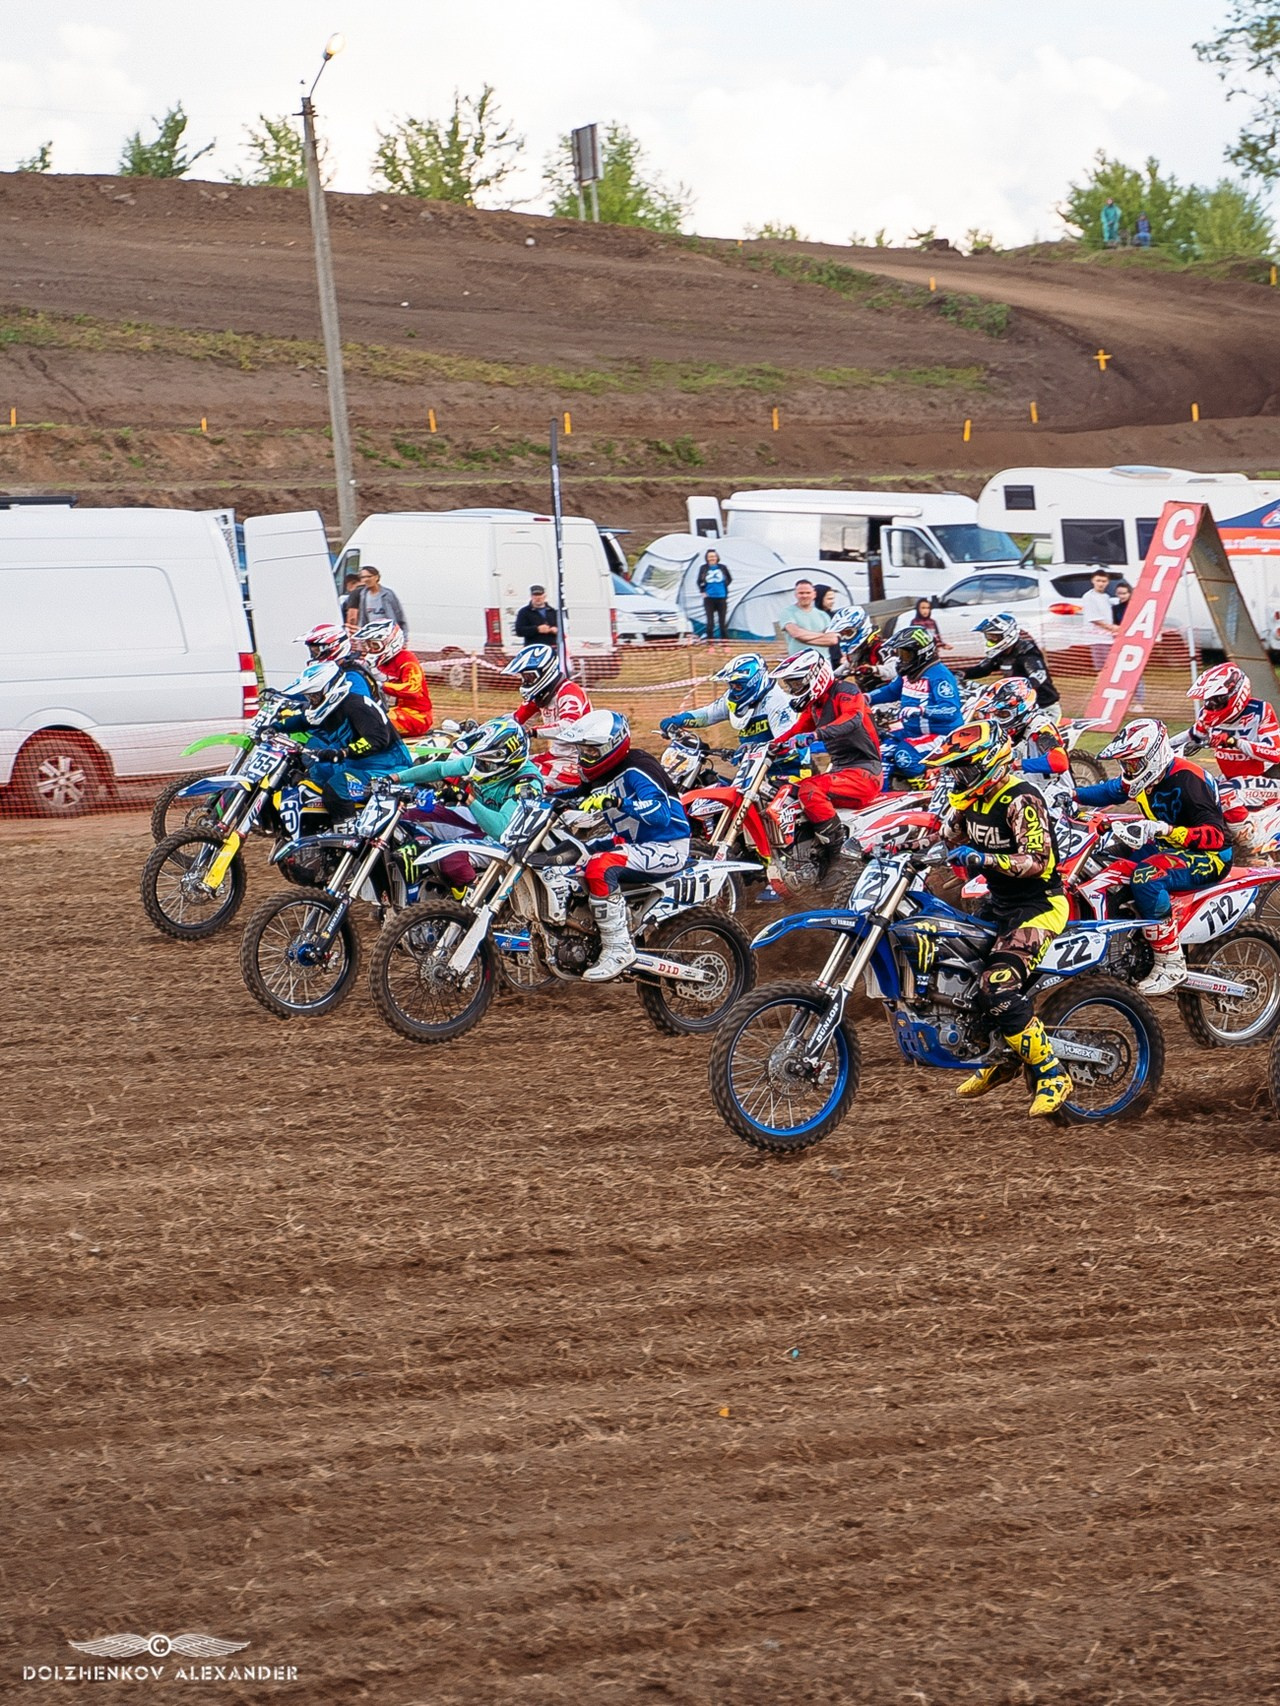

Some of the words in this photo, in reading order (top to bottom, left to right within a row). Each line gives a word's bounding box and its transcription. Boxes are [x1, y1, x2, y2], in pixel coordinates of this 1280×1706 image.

[1101, 508, 1195, 721] СТАРТ
[1245, 791, 1278, 799] HONDA
[327, 902, 345, 933] DUNLOP
[837, 919, 856, 927] YAMAHA
[1199, 895, 1240, 937] 712
[1054, 935, 1092, 971] 22
[658, 963, 680, 976] DID
[1212, 983, 1227, 993] DID
[816, 1002, 840, 1043] DUNLOP
